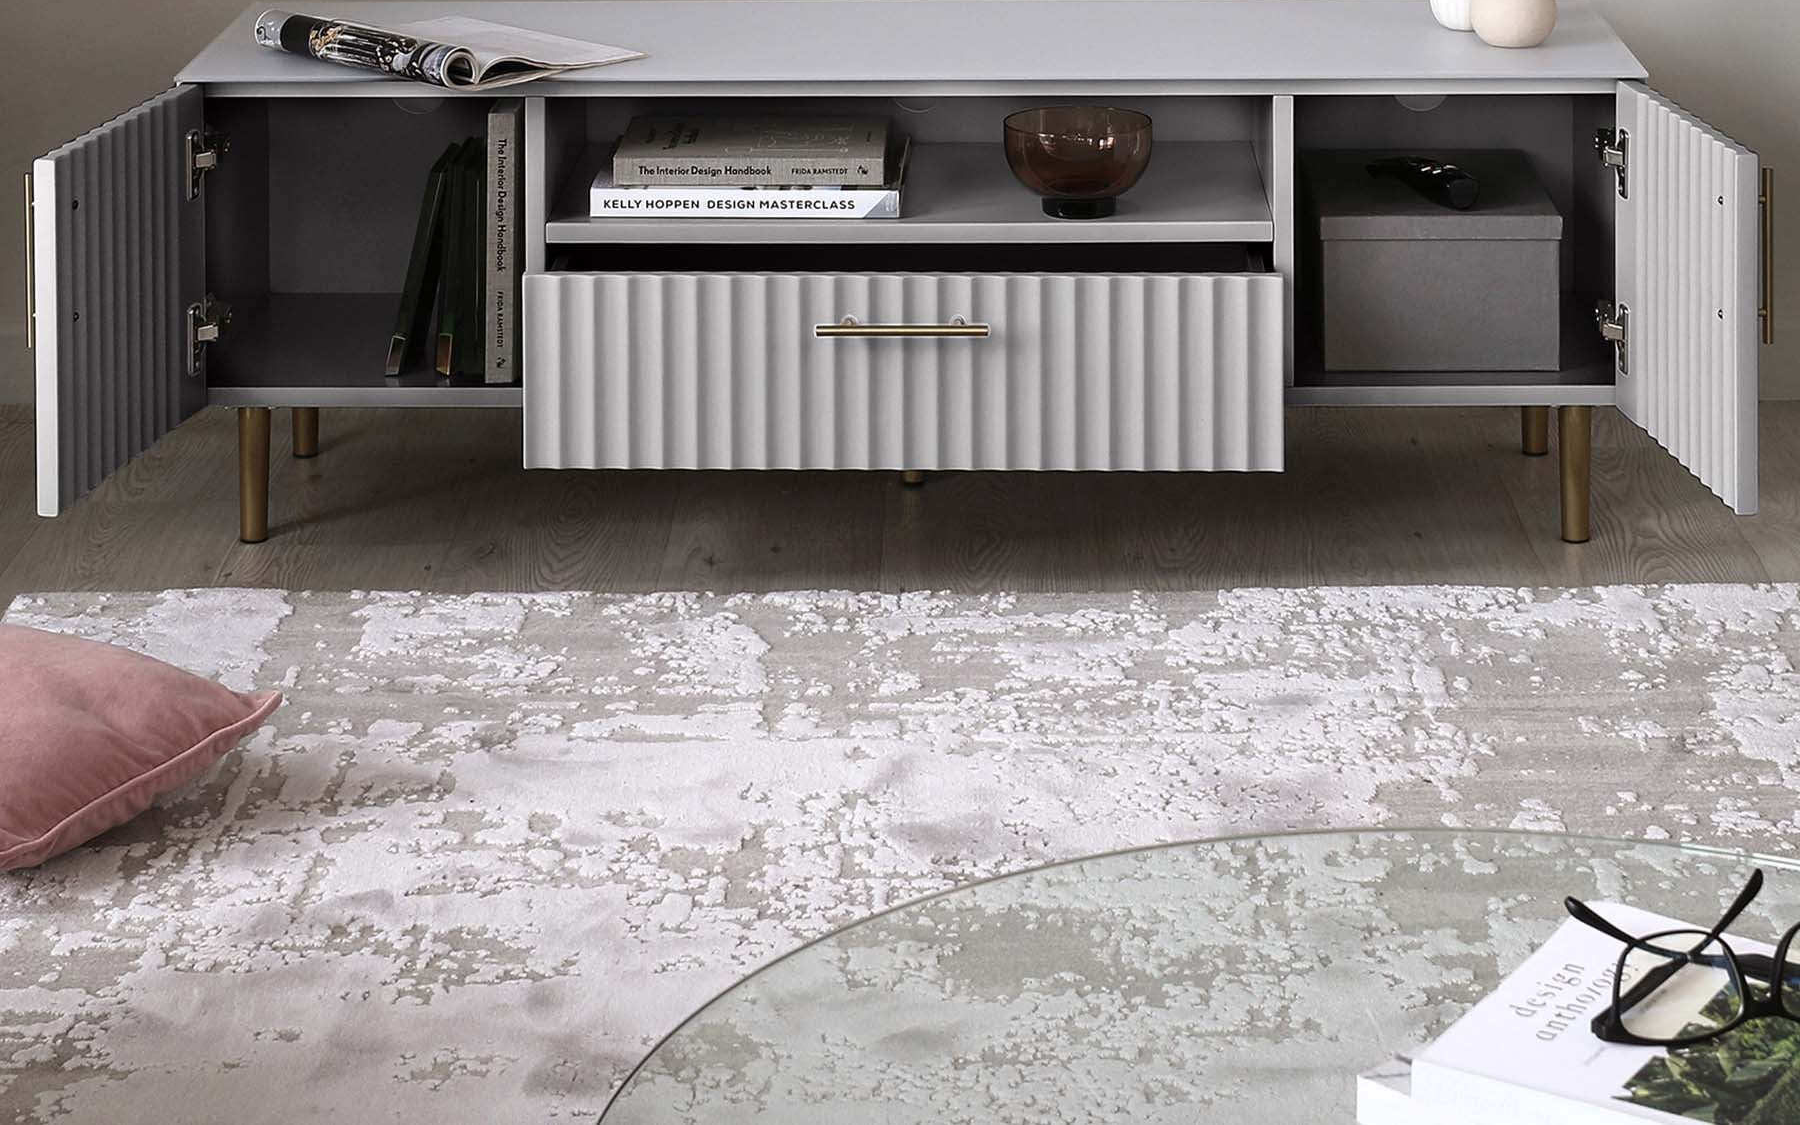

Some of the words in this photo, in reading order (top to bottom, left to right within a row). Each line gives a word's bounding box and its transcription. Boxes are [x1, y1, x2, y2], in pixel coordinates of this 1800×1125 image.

[498, 139, 507, 155] The
[498, 156, 507, 189] Interior
[638, 166, 655, 175] The
[656, 166, 690, 175] Interior
[691, 166, 722, 177] Design
[724, 166, 772, 175] Handbook
[496, 191, 507, 222] Design
[603, 200, 642, 209] KELLY
[645, 200, 700, 209] HOPPEN
[707, 200, 755, 209] DESIGN
[759, 200, 855, 210] MASTERCLASS
[497, 224, 507, 271] Handbook
[1509, 963, 1585, 1018] design
